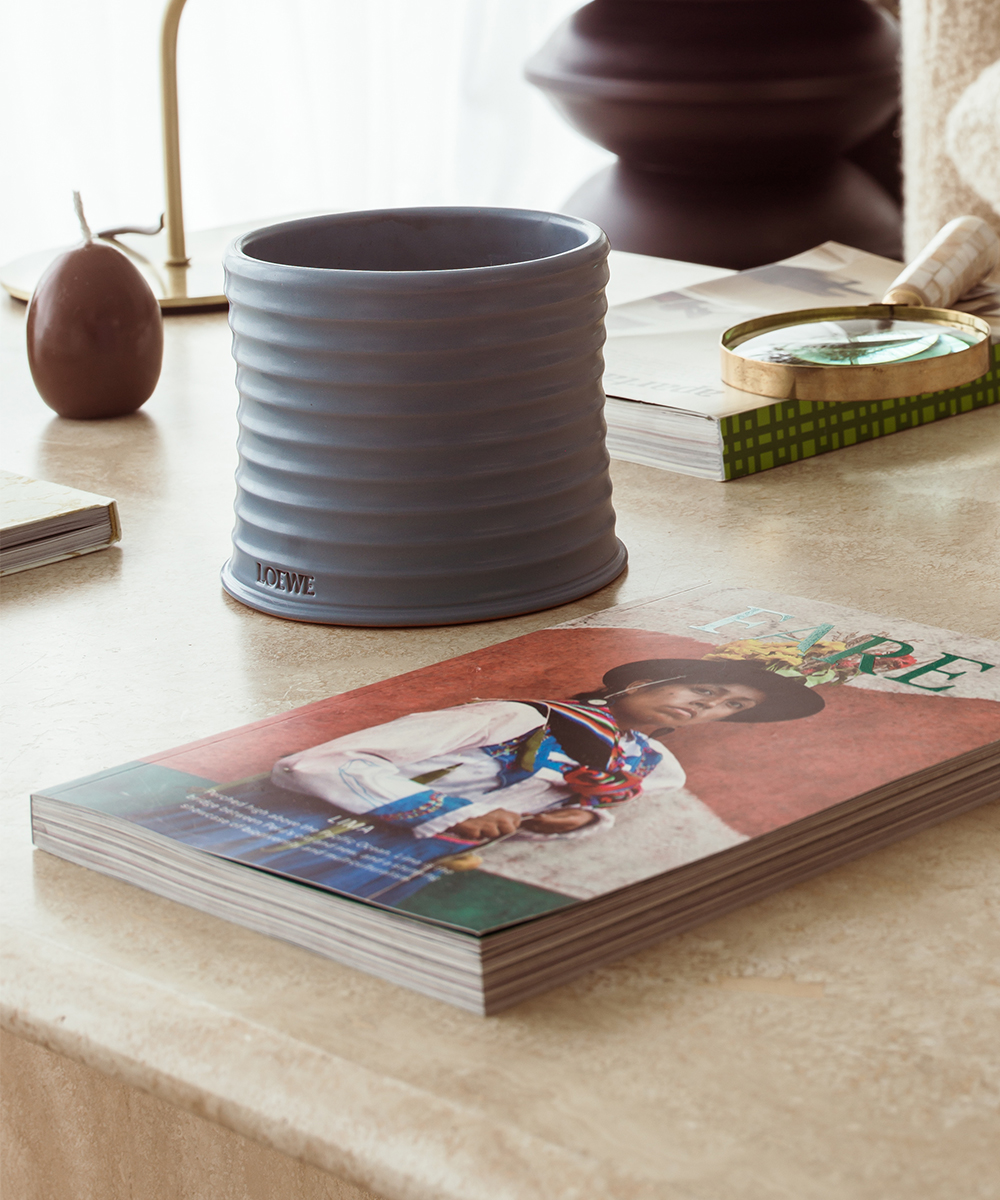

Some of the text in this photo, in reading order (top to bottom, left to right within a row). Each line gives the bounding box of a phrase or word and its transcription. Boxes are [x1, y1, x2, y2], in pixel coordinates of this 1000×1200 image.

[255, 561, 317, 597] LOEWE
[689, 605, 996, 693] FARE
[327, 814, 375, 834] LIMA
